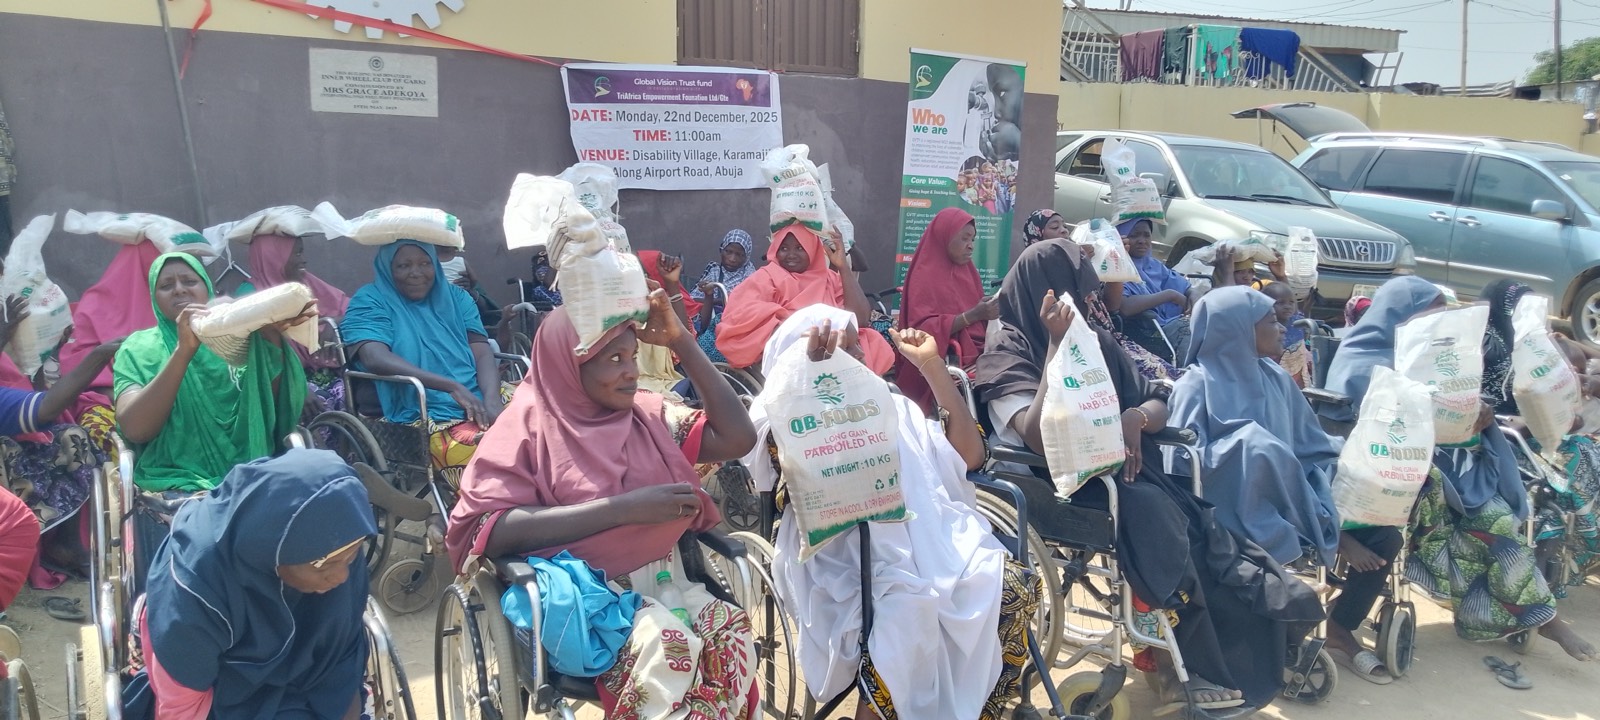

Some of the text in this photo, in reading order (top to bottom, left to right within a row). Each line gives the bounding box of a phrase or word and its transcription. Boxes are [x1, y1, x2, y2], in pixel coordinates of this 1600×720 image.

[634, 78, 656, 86] Global
[656, 78, 678, 86] Vision
[679, 79, 696, 87] Trust
[616, 91, 642, 100] TriAfrica
[642, 92, 682, 102] Empowerment
[571, 109, 778, 124] DATE: Monday, 22nd December, 2025
[912, 108, 945, 126] Who
[633, 129, 722, 141] TIME: 11:00am
[912, 125, 948, 135] we are
[579, 149, 630, 161] VENUE:
[632, 149, 682, 162] Disability
[683, 149, 721, 163] Village,
[613, 165, 744, 180] Along Airport Road, Abuja
[910, 176, 927, 184] Core
[824, 431, 847, 444] LONG
[804, 438, 865, 459] PARBOILED
[821, 467, 834, 479] NET
[835, 461, 860, 476] WEIGHT
[876, 453, 891, 465] KG
[820, 509, 838, 520] STORE
